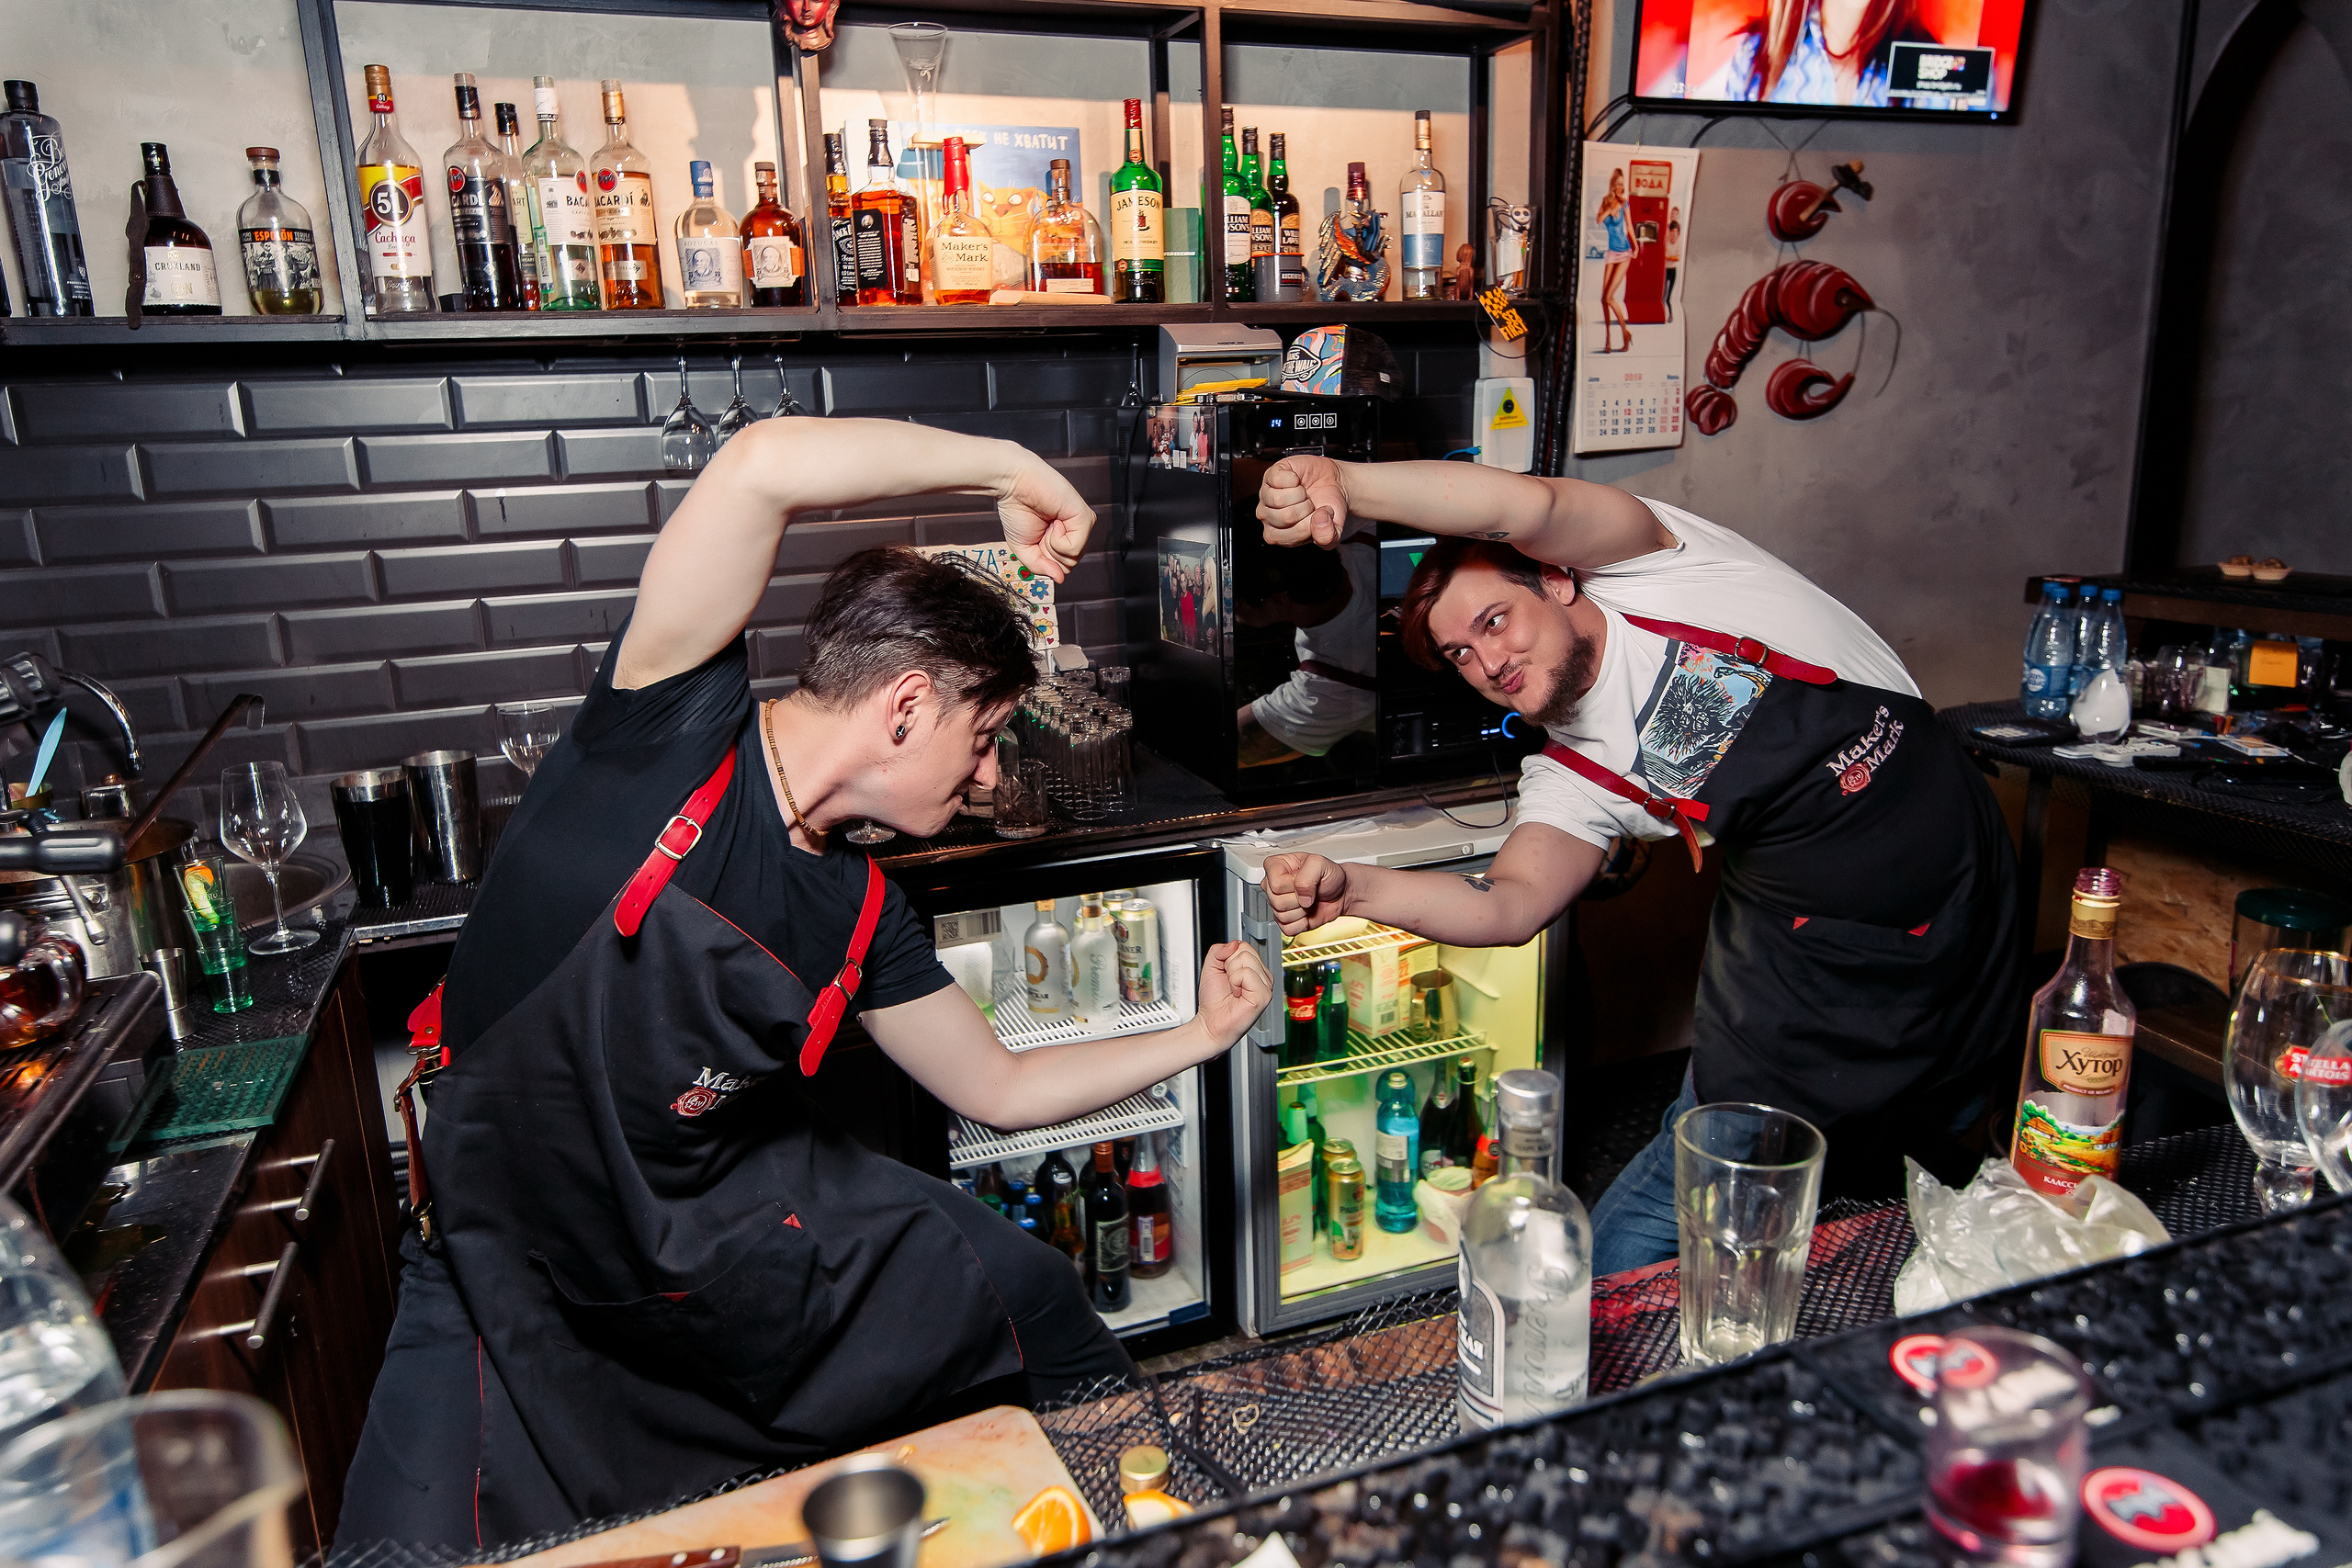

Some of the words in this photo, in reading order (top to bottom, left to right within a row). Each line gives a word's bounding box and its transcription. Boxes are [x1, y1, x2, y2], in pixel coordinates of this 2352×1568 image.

[993, 131, 1010, 146] НЕ
[1014, 132, 1069, 151] ХВАТИТ
[1635, 178, 1663, 188] ВОДА
[377, 191, 404, 215] 51
[1406, 210, 1443, 219] MAALLAN
[254, 229, 294, 242] ESPOÒN
[941, 242, 989, 251] Maker's
[956, 253, 989, 262] Mark
[154, 262, 201, 271] CRUXLAND
[1271, 419, 1283, 428] 14
[1826, 705, 1891, 777] Maker's
[1862, 719, 1905, 773] Mark
[2055, 1048, 2123, 1077] Хутор
